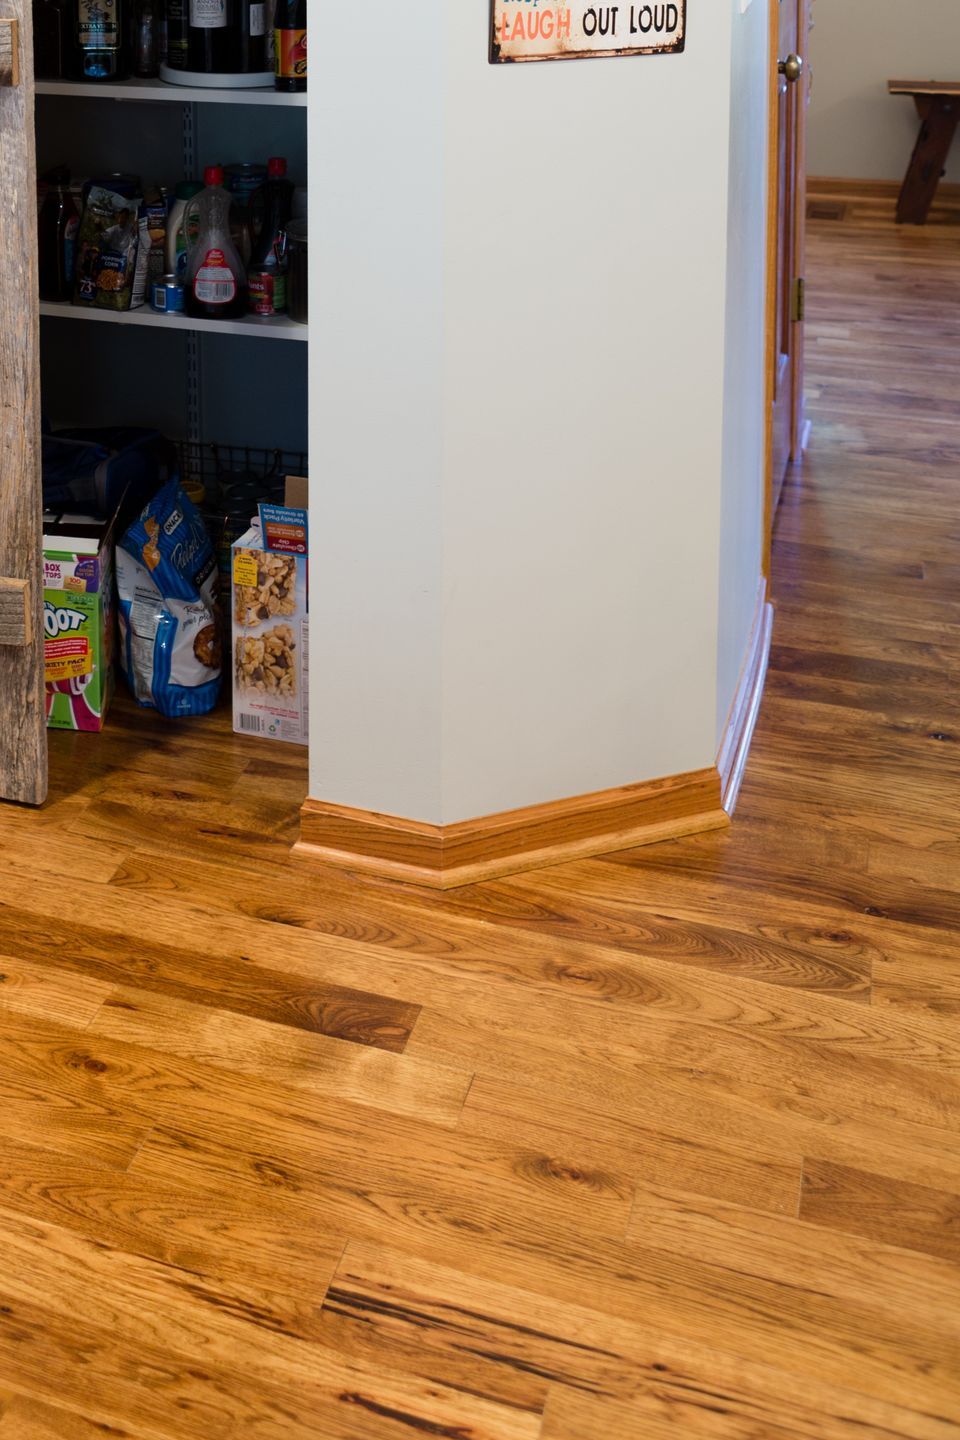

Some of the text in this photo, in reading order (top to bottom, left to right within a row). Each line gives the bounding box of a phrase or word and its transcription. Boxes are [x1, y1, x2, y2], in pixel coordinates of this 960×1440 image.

[500, 3, 678, 41] LAUGH OUT LOUD
[165, 513, 181, 532] SNACK
[45, 563, 60, 572] BOX
[45, 571, 61, 579] TOPS
[44, 608, 88, 637] OOT
